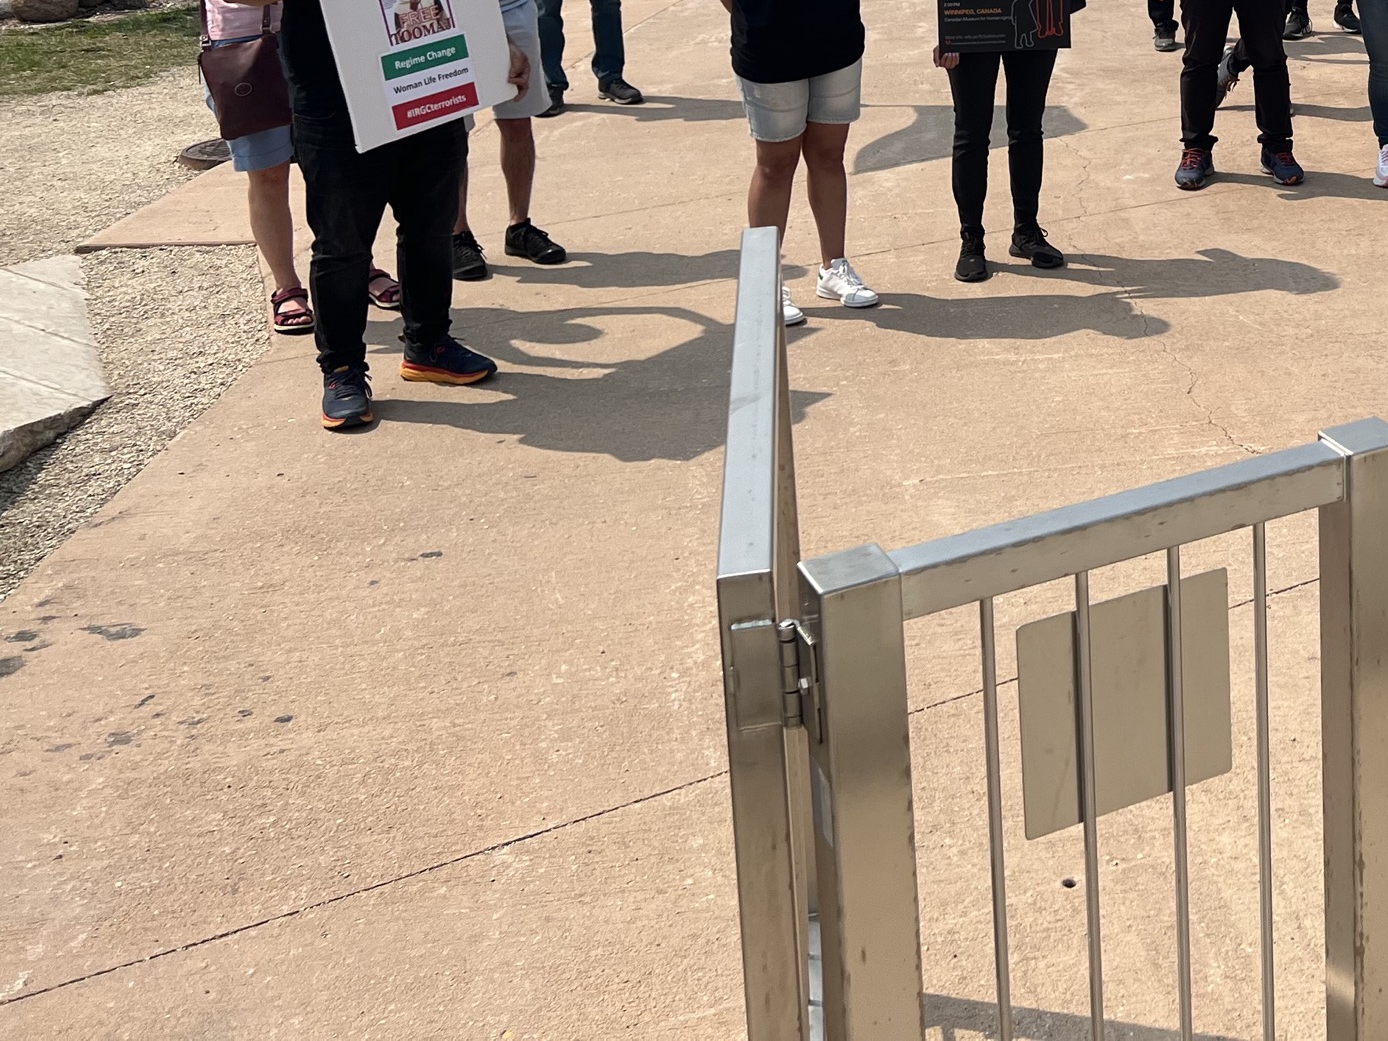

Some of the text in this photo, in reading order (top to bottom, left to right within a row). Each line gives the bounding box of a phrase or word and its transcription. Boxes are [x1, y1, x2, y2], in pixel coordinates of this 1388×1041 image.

[398, 5, 440, 28] FREE
[976, 7, 1002, 15] CANADA
[390, 17, 452, 45] TOOMAJ
[394, 47, 456, 70] Regime Change
[393, 67, 469, 95] Woman Life Freedom
[406, 95, 466, 119] #IRGCterrorists
